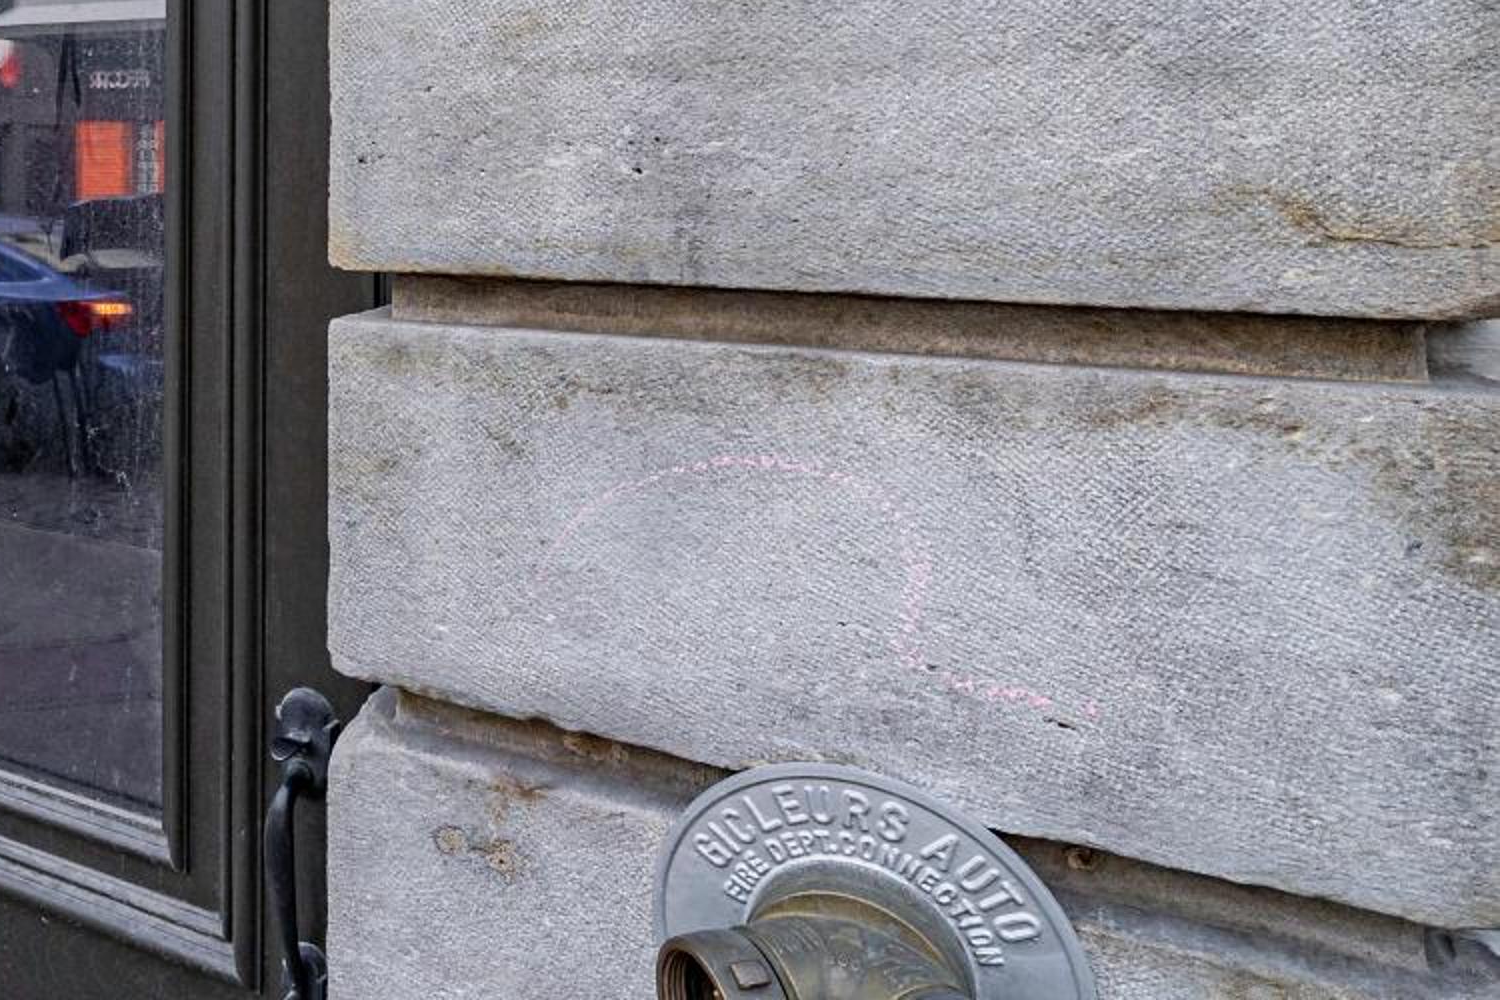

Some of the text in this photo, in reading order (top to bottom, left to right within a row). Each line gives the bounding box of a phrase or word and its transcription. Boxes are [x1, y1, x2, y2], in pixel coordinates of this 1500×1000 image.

[694, 784, 1042, 943] GICLEURS AUTO
[724, 850, 771, 904] FIRE
